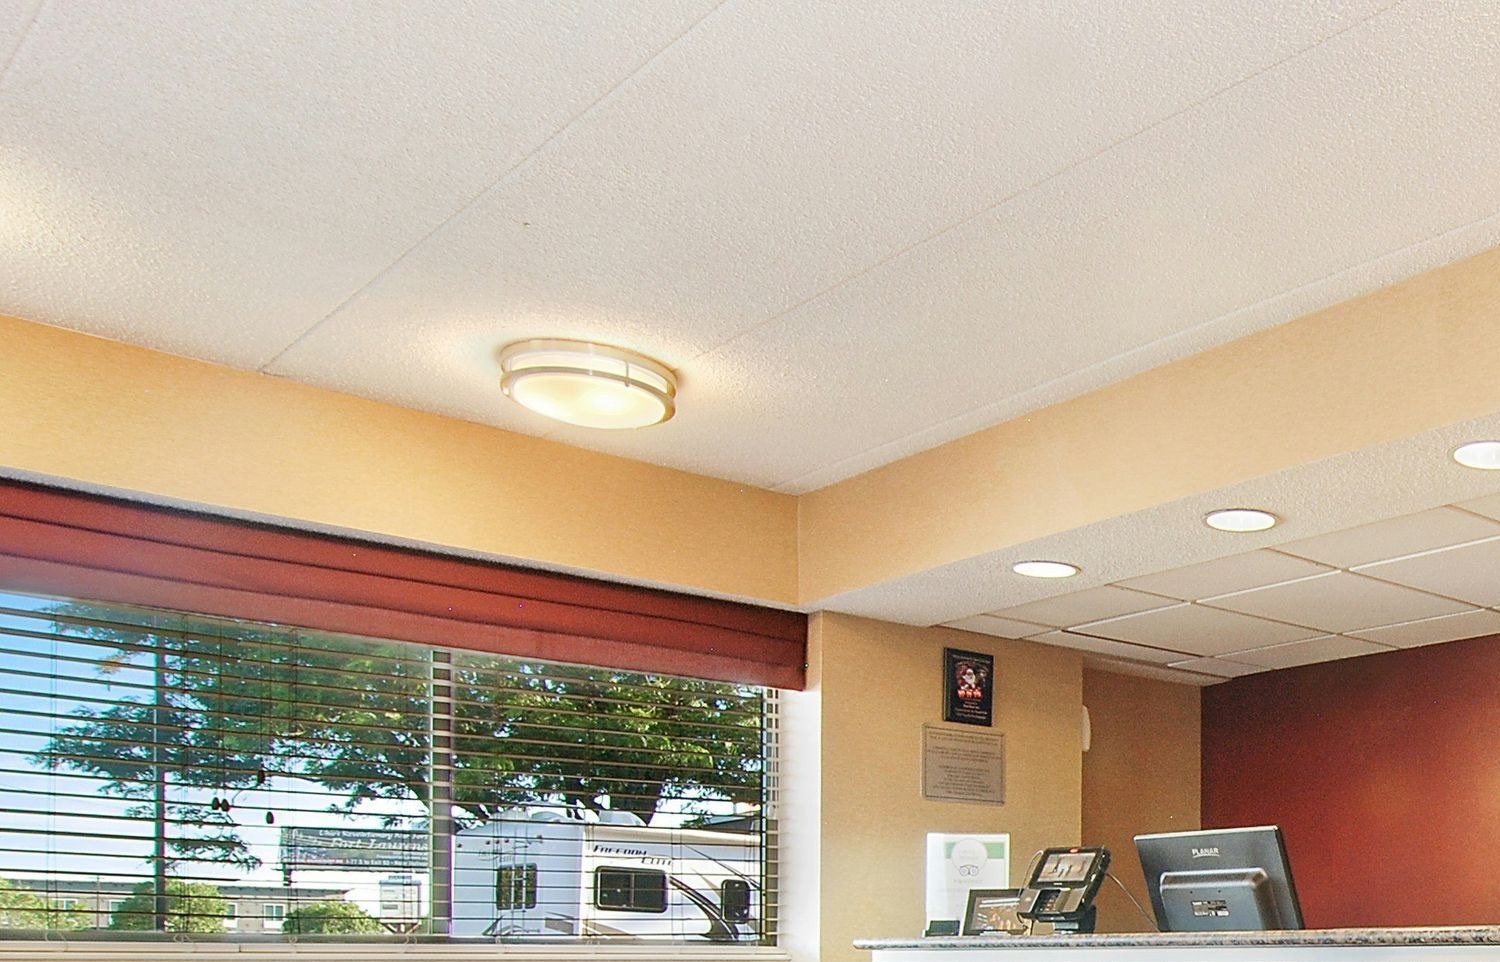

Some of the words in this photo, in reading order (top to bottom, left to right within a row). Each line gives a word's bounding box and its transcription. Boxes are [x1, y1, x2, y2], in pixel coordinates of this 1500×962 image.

[330, 837, 362, 849] Fort
[367, 838, 429, 851] Laurens
[1191, 847, 1219, 857] PLANAR
